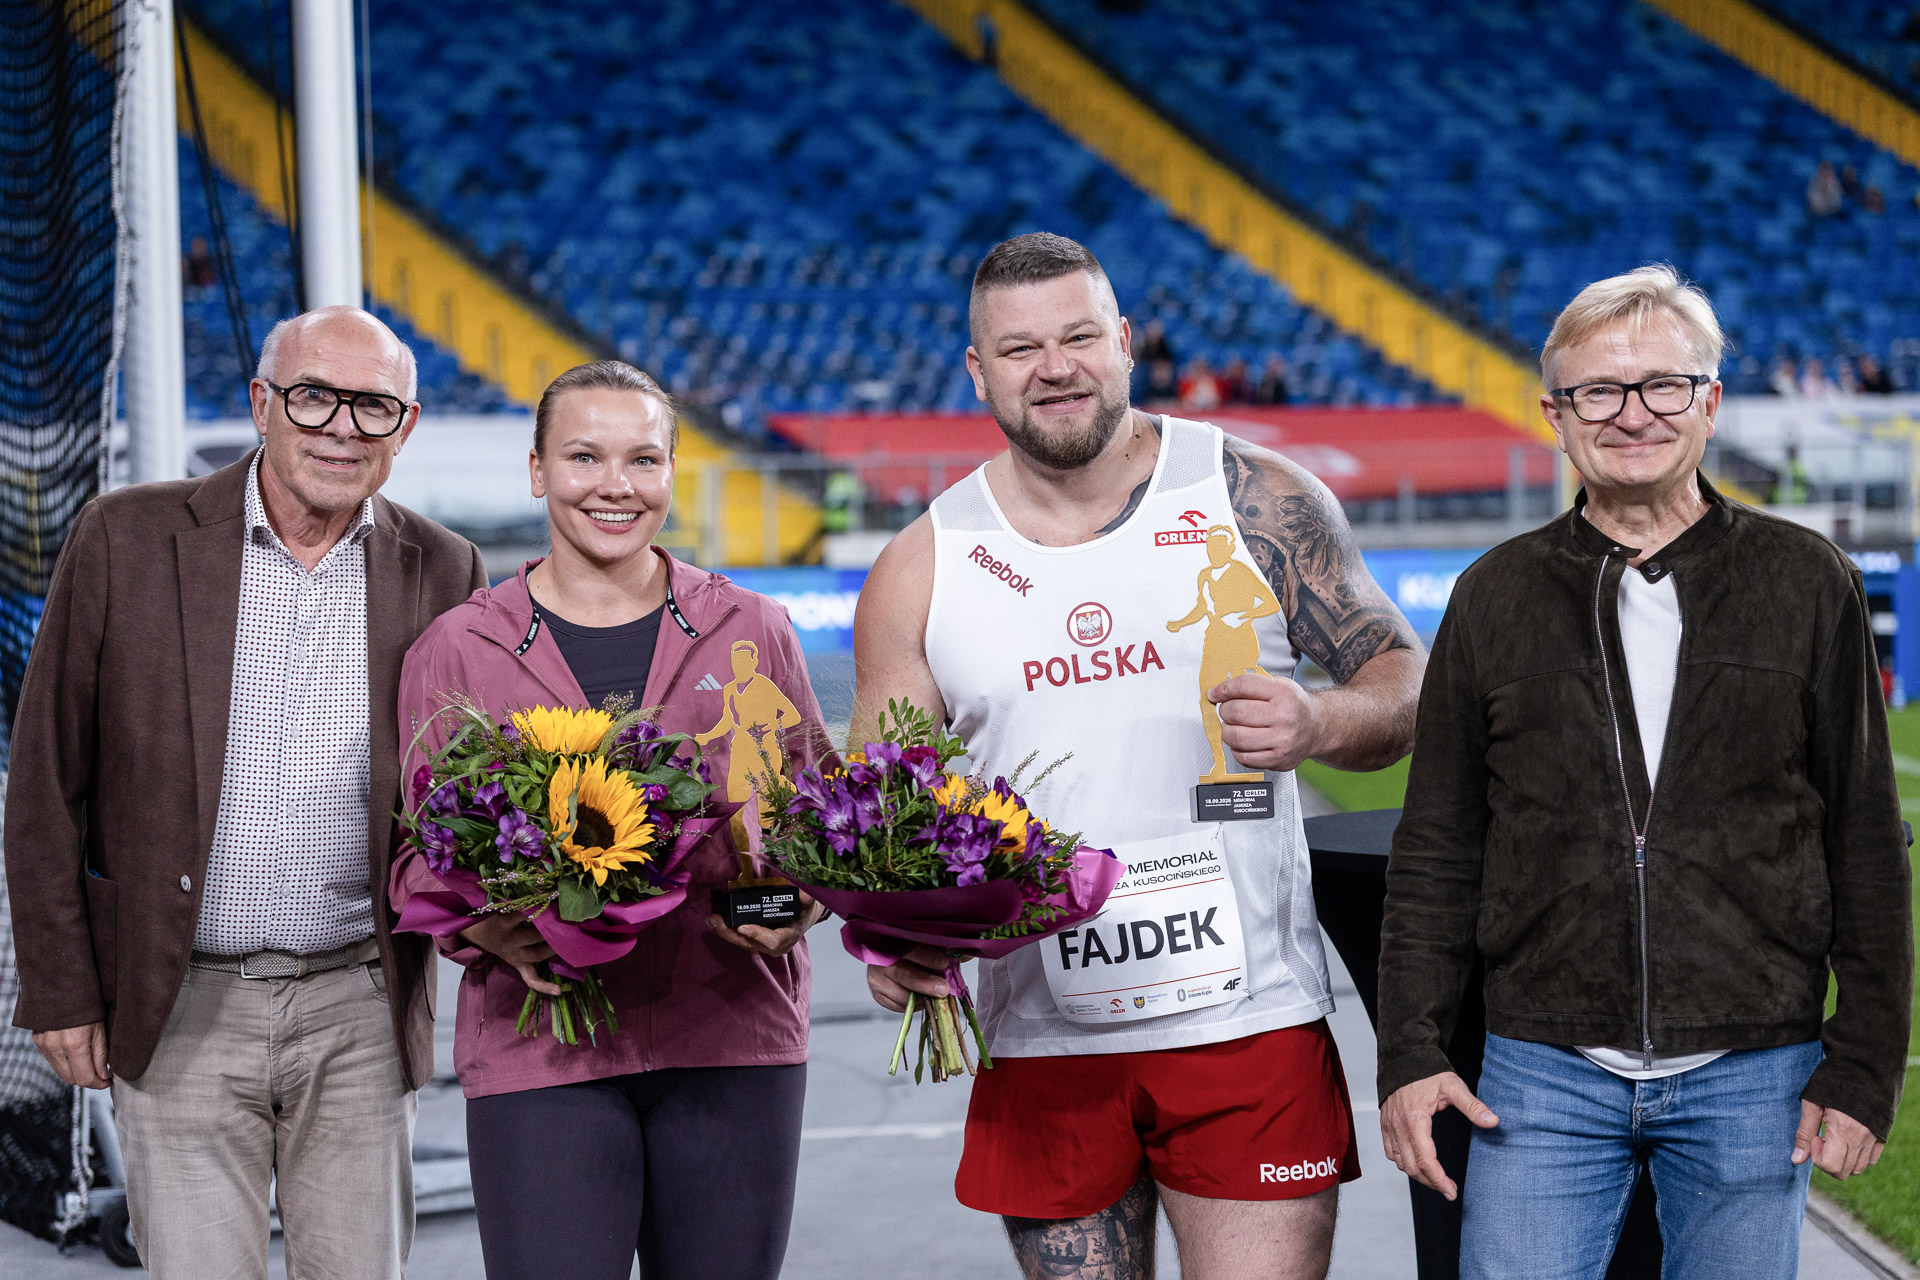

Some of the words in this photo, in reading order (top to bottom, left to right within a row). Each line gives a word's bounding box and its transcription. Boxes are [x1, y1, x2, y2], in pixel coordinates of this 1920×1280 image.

[1157, 531, 1207, 544] ORLEN
[968, 544, 1034, 597] Reebok
[1023, 640, 1165, 692] POLSKA
[1128, 850, 1218, 875] MEMORIAŁ
[1133, 865, 1221, 887] KUSOCIŃSKIEGO
[1057, 906, 1225, 970] FAJDEK
[1260, 1156, 1338, 1183] Reebok
